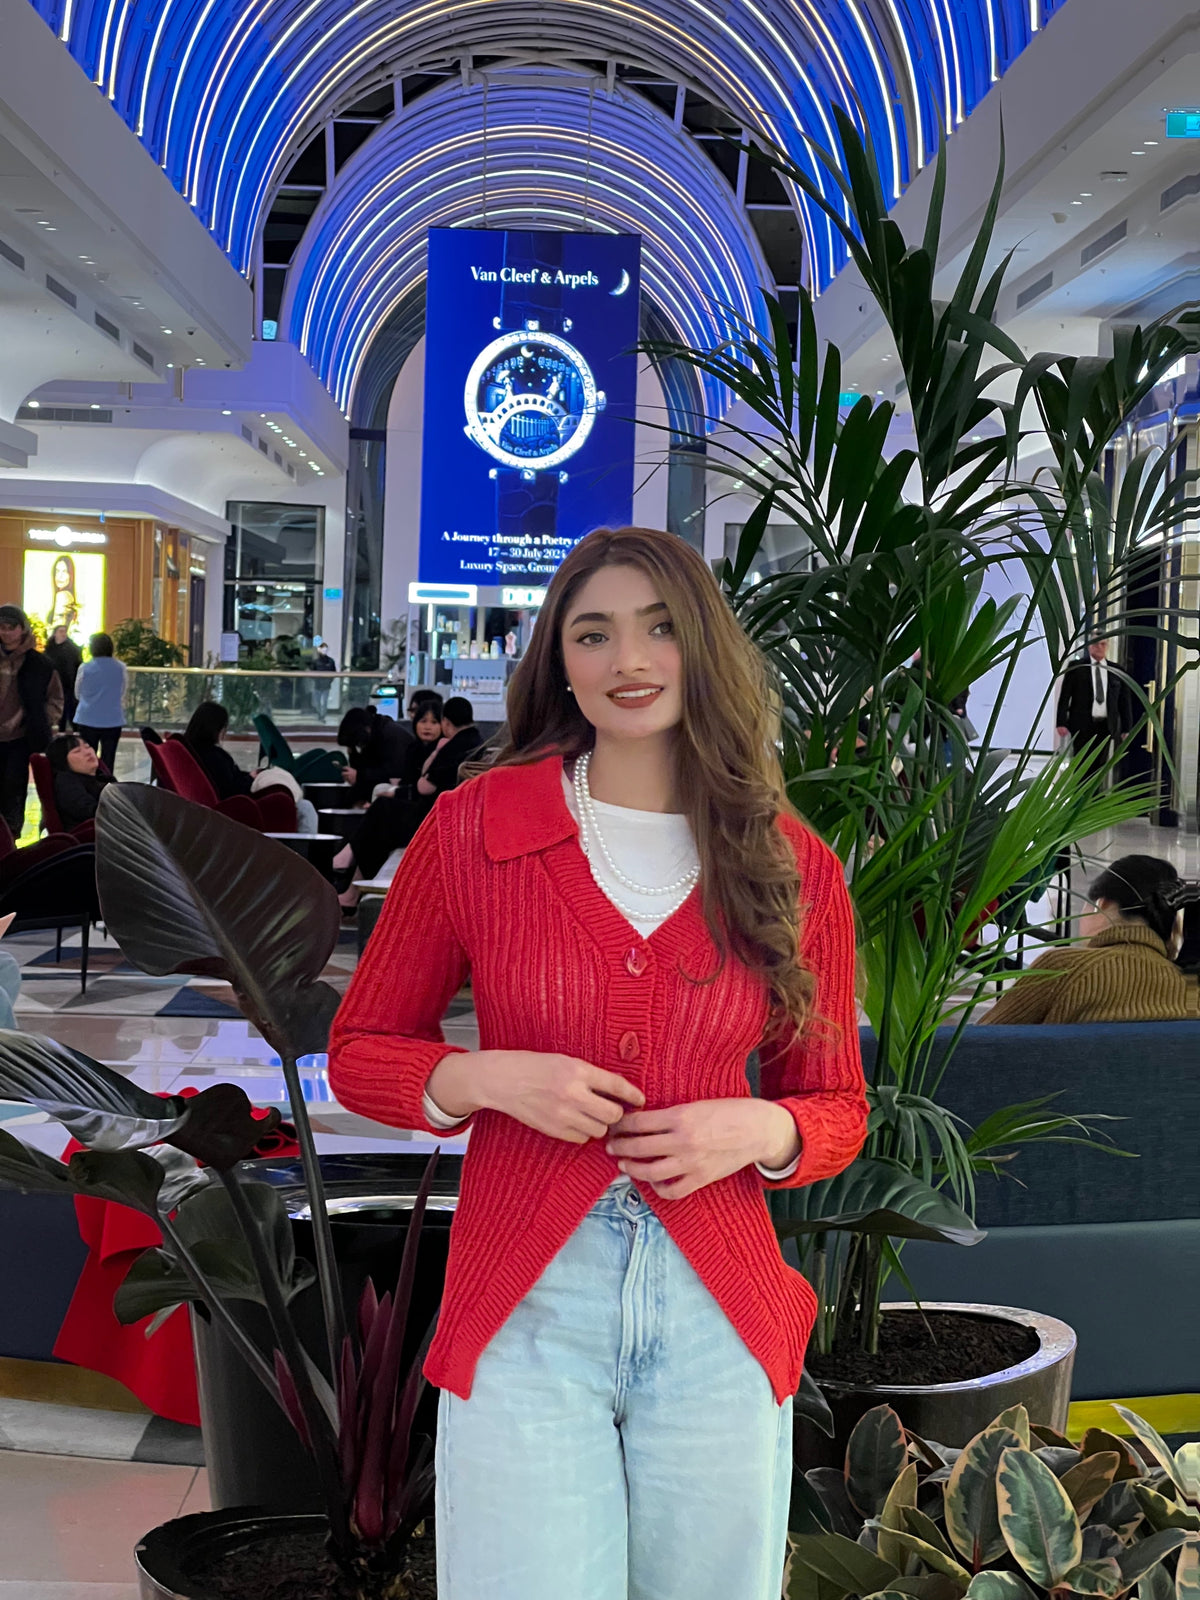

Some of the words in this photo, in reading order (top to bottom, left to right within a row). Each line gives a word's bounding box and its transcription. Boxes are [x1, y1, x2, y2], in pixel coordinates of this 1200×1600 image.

[470, 266, 497, 281] Van
[500, 267, 539, 283] Cleef
[540, 272, 552, 284] &
[554, 269, 599, 289] Arpels
[441, 531, 450, 541] A
[452, 531, 490, 545] Journey
[492, 533, 532, 547] through
[533, 536, 541, 545] a
[542, 534, 572, 548] Poetry
[488, 547, 499, 557] 17
[522, 547, 542, 561] July
[460, 559, 493, 573] Luxury
[527, 562, 559, 573] Groun
